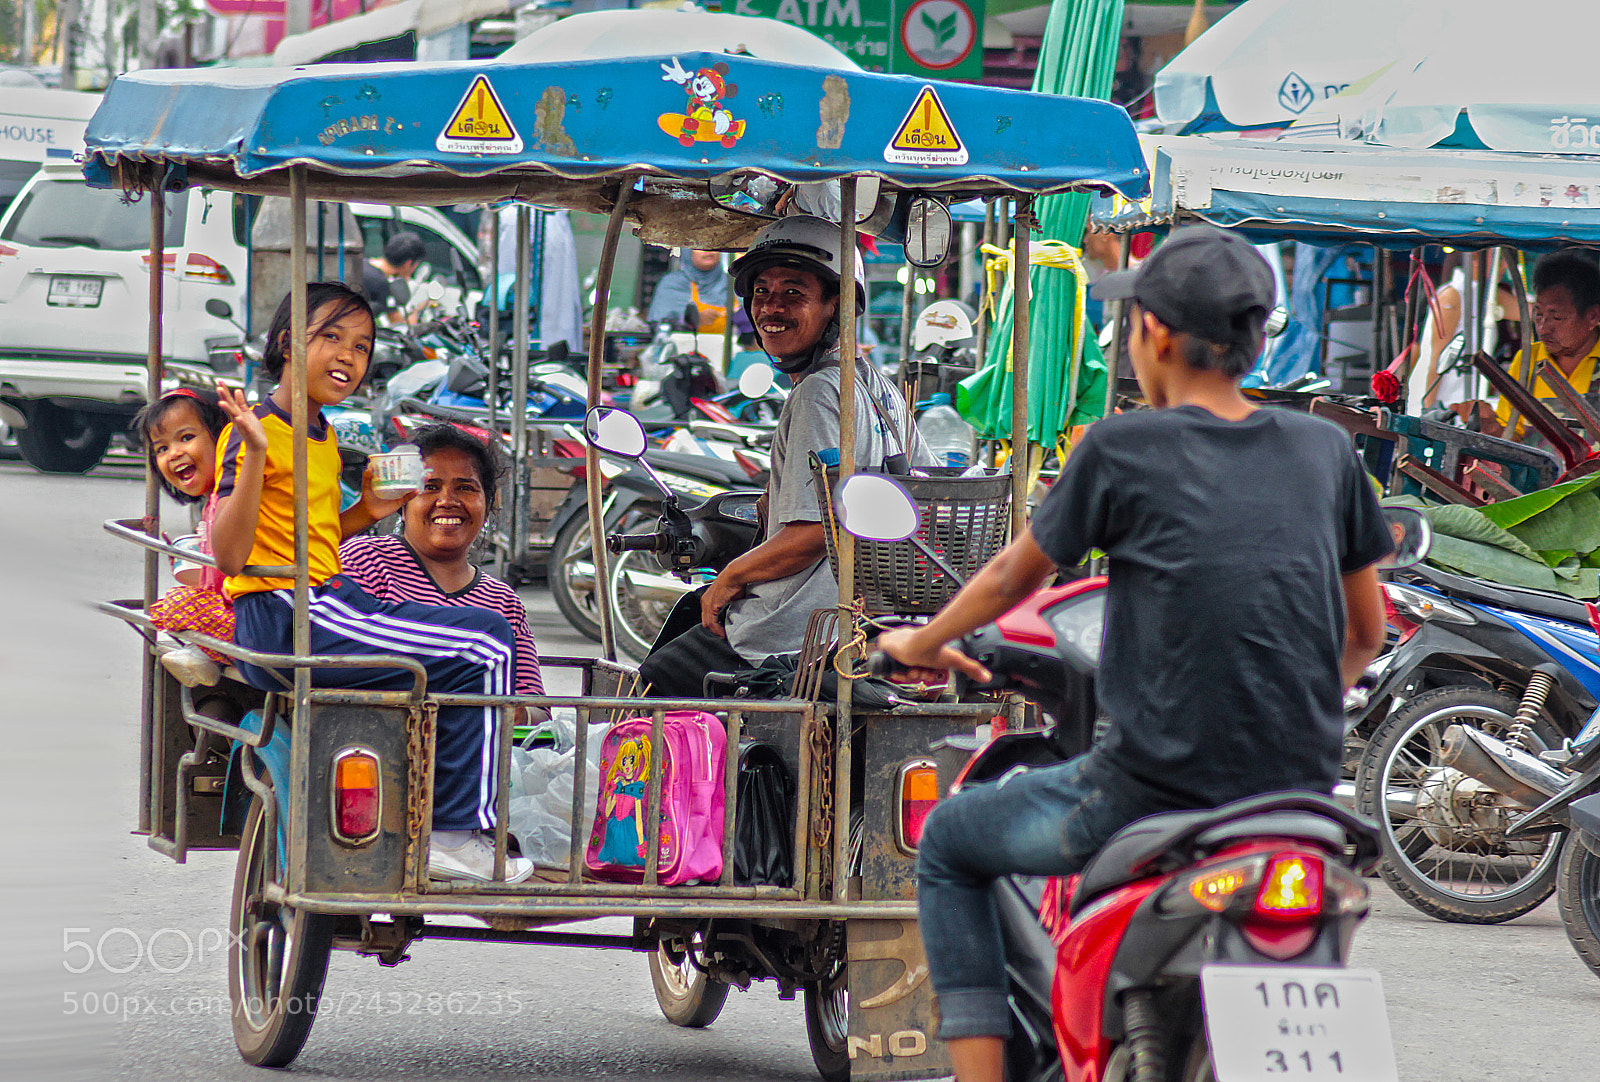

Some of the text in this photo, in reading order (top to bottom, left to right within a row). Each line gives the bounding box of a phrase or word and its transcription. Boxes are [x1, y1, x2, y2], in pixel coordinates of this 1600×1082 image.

[775, 0, 862, 27] ATM
[0, 125, 56, 144] HOUSE
[1265, 1050, 1343, 1074] 311
